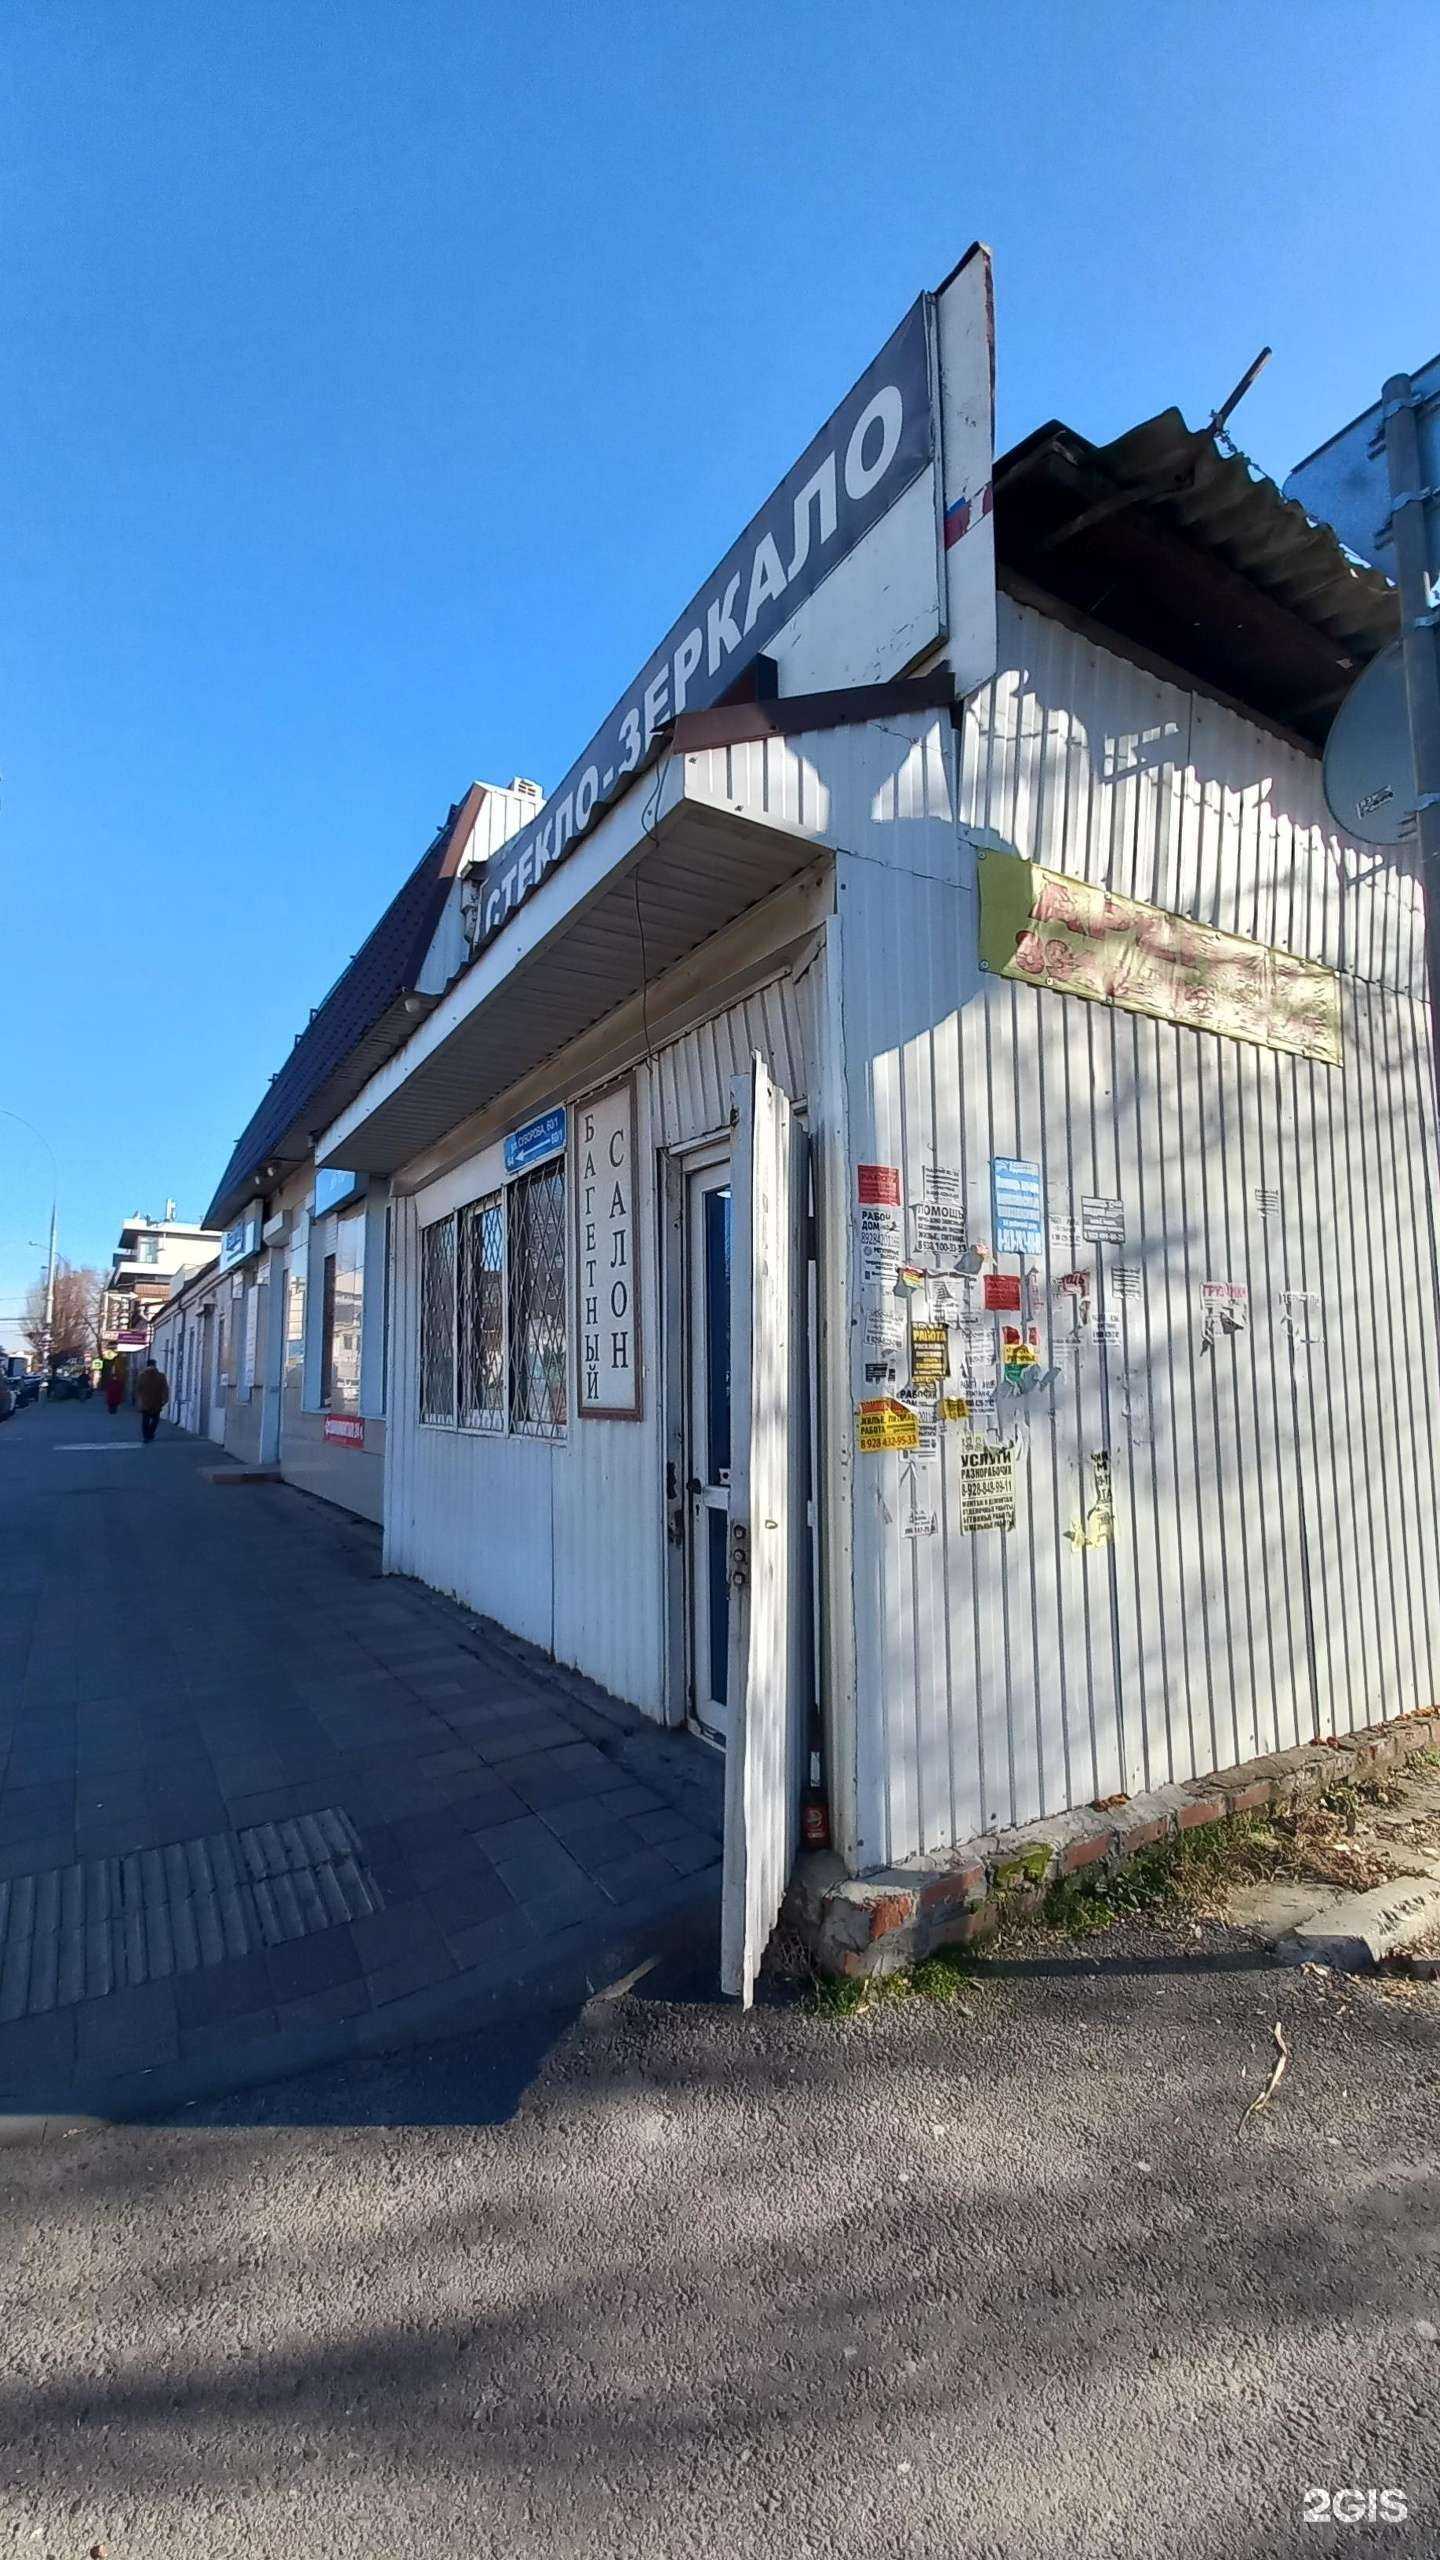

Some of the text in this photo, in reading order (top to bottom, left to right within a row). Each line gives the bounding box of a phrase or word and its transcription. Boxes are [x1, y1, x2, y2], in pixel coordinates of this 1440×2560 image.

[584, 1114, 600, 1400] БАГЕТНЫЙ
[608, 1129, 629, 1370] САЛОН
[860, 1425, 887, 1435] РАБОТА
